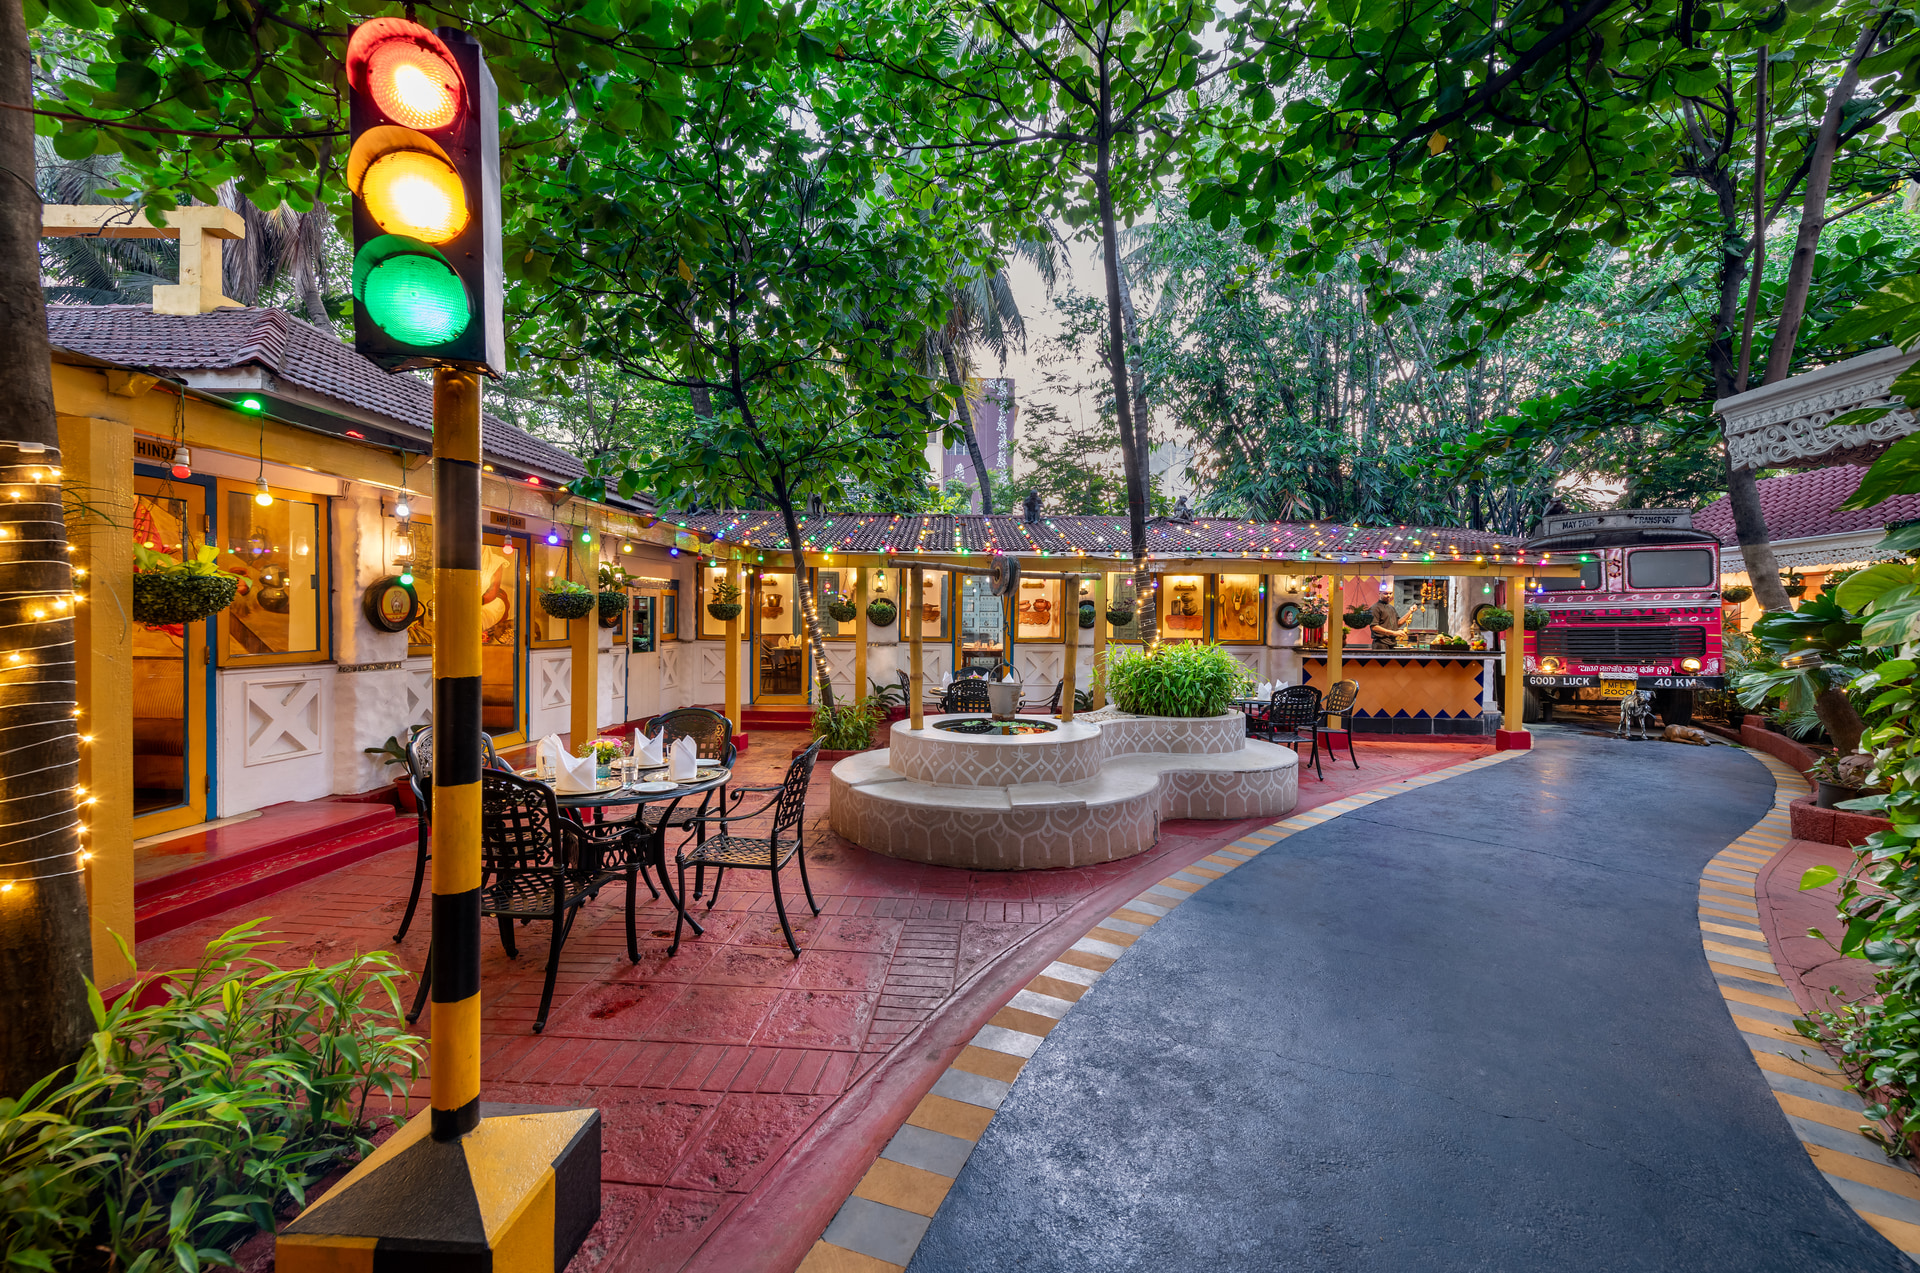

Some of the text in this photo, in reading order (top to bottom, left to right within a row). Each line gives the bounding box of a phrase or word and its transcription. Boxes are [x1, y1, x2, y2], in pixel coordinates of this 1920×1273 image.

[1634, 516, 1678, 524] TRANSPORT
[1605, 607, 1715, 616] LEYLAND
[1530, 677, 1696, 687] GOOD LUCK 40 KM
